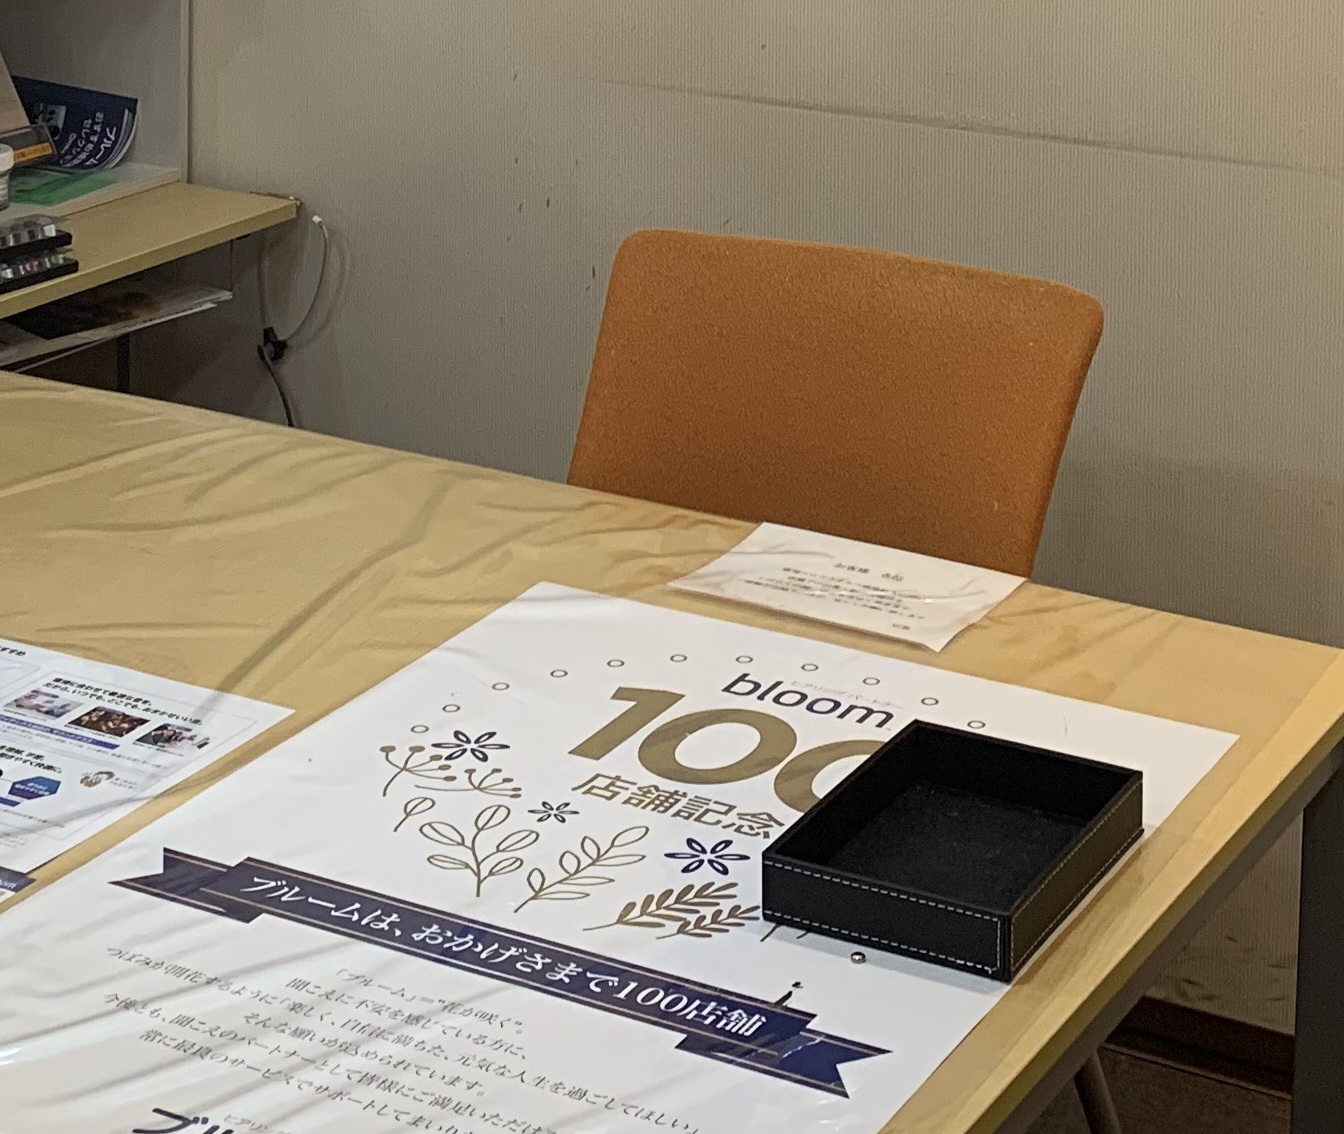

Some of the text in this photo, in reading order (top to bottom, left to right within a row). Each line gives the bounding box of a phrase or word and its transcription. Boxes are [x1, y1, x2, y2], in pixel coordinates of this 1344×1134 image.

[568, 686, 888, 815] 100
[721, 672, 895, 729] bloom
[571, 772, 786, 840] 店舗記念
[241, 872, 769, 1039] ブルームは、おかげさまで100店舗
[138, 1030, 472, 1134] 常に最良のサービスでサポートしてまいり
